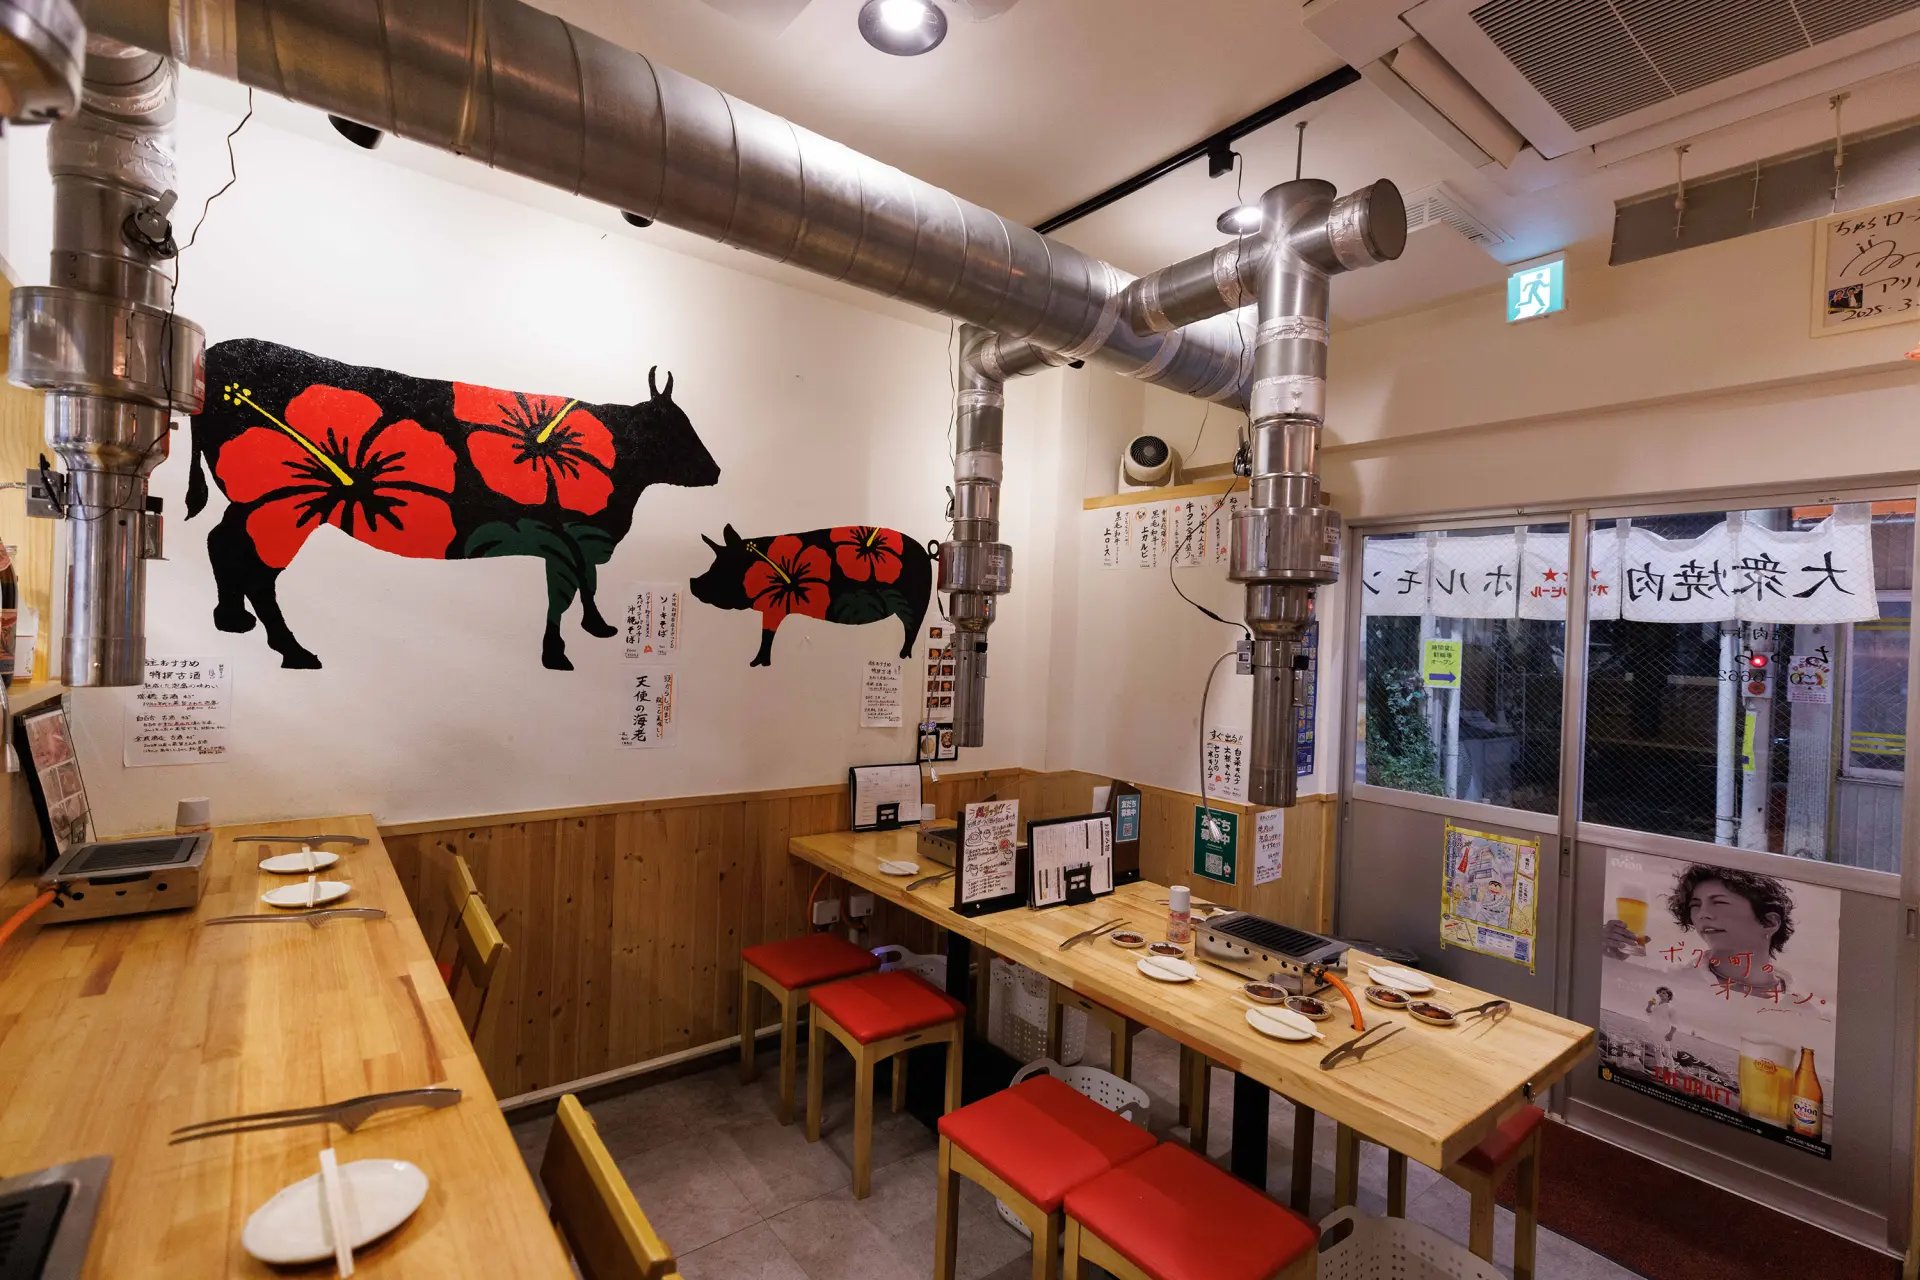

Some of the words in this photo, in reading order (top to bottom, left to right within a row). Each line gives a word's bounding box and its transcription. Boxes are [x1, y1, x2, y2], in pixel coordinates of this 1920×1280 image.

[1103, 527, 1112, 556] 上ロース
[1141, 525, 1149, 558] 上カルビ
[626, 605, 640, 644] 沖縄そば
[658, 596, 669, 638] ソーキそば
[631, 675, 651, 742] 天使の海老
[1223, 746, 1232, 783] 大根キムチ
[1233, 747, 1242, 785] 白菜キムチ
[1121, 800, 1136, 808] 友だち
[1201, 828, 1231, 845] 募中
[1658, 942, 1775, 978] ボクの町の
[1683, 1073, 1735, 1107] DRAFT
[1793, 1102, 1818, 1118] Orion
